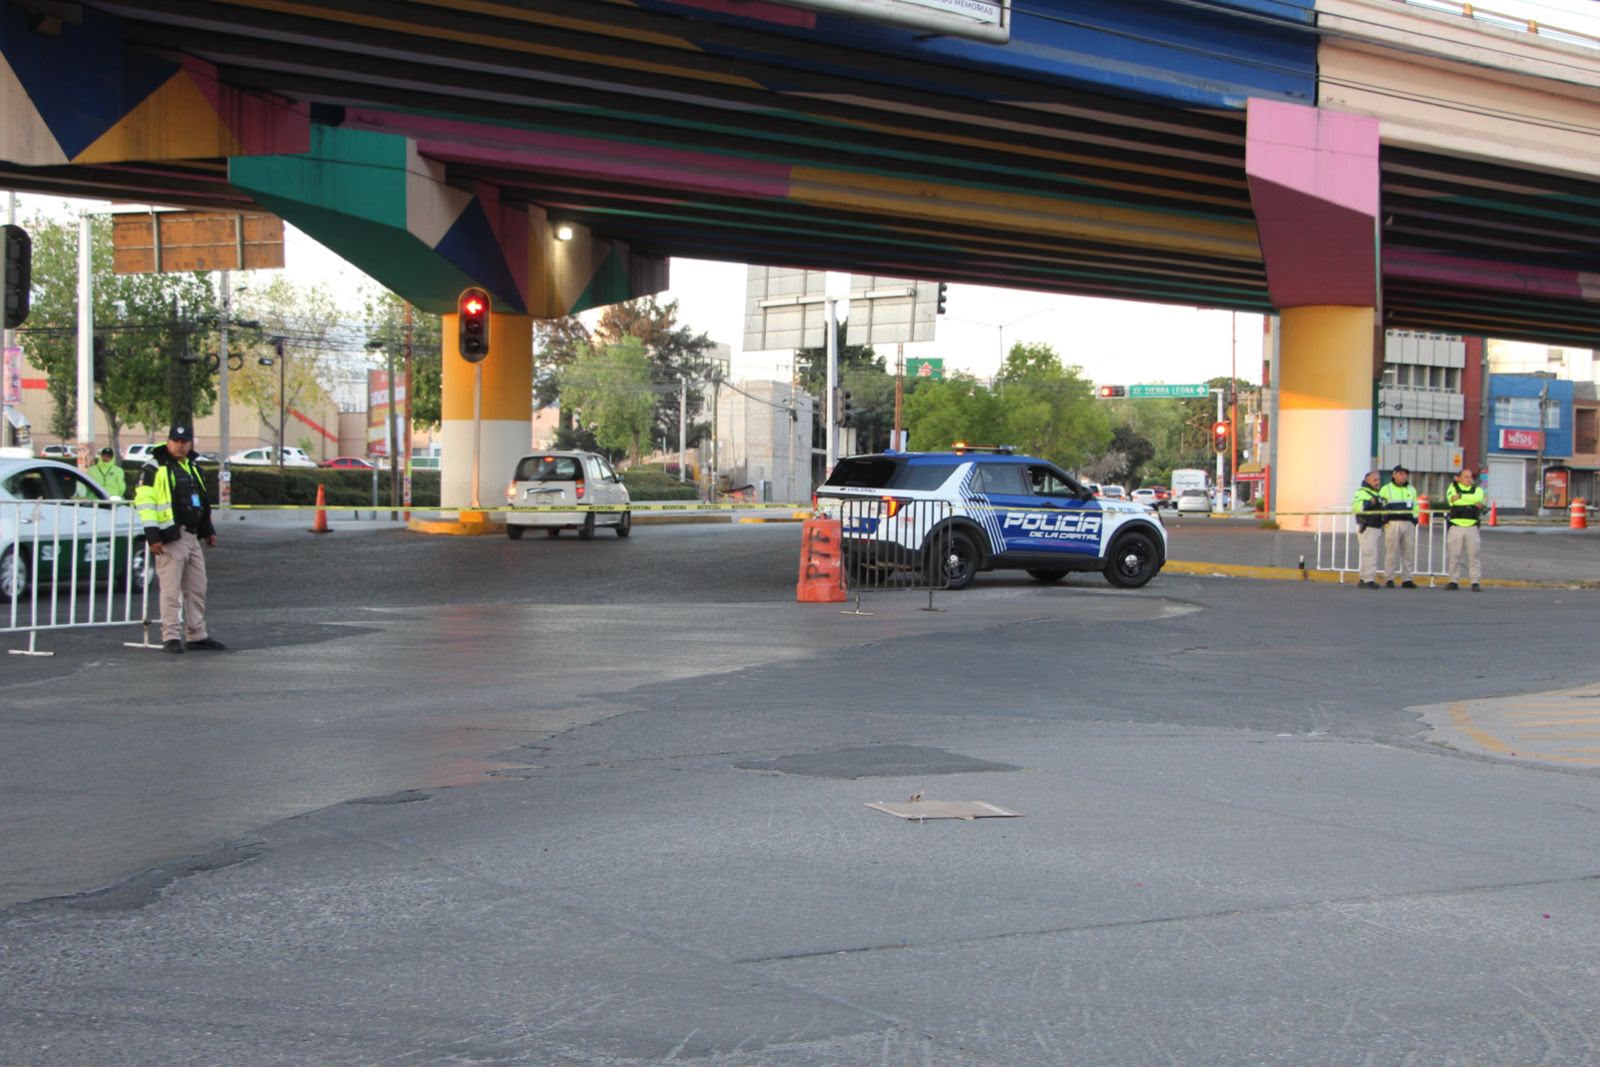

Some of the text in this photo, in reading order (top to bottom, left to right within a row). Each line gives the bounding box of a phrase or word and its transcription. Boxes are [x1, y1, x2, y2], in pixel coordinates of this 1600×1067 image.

[954, 0, 993, 16] MEMORIAS
[1003, 511, 1102, 533] POLICÍA
[1059, 532, 1100, 541] CAPITAL
